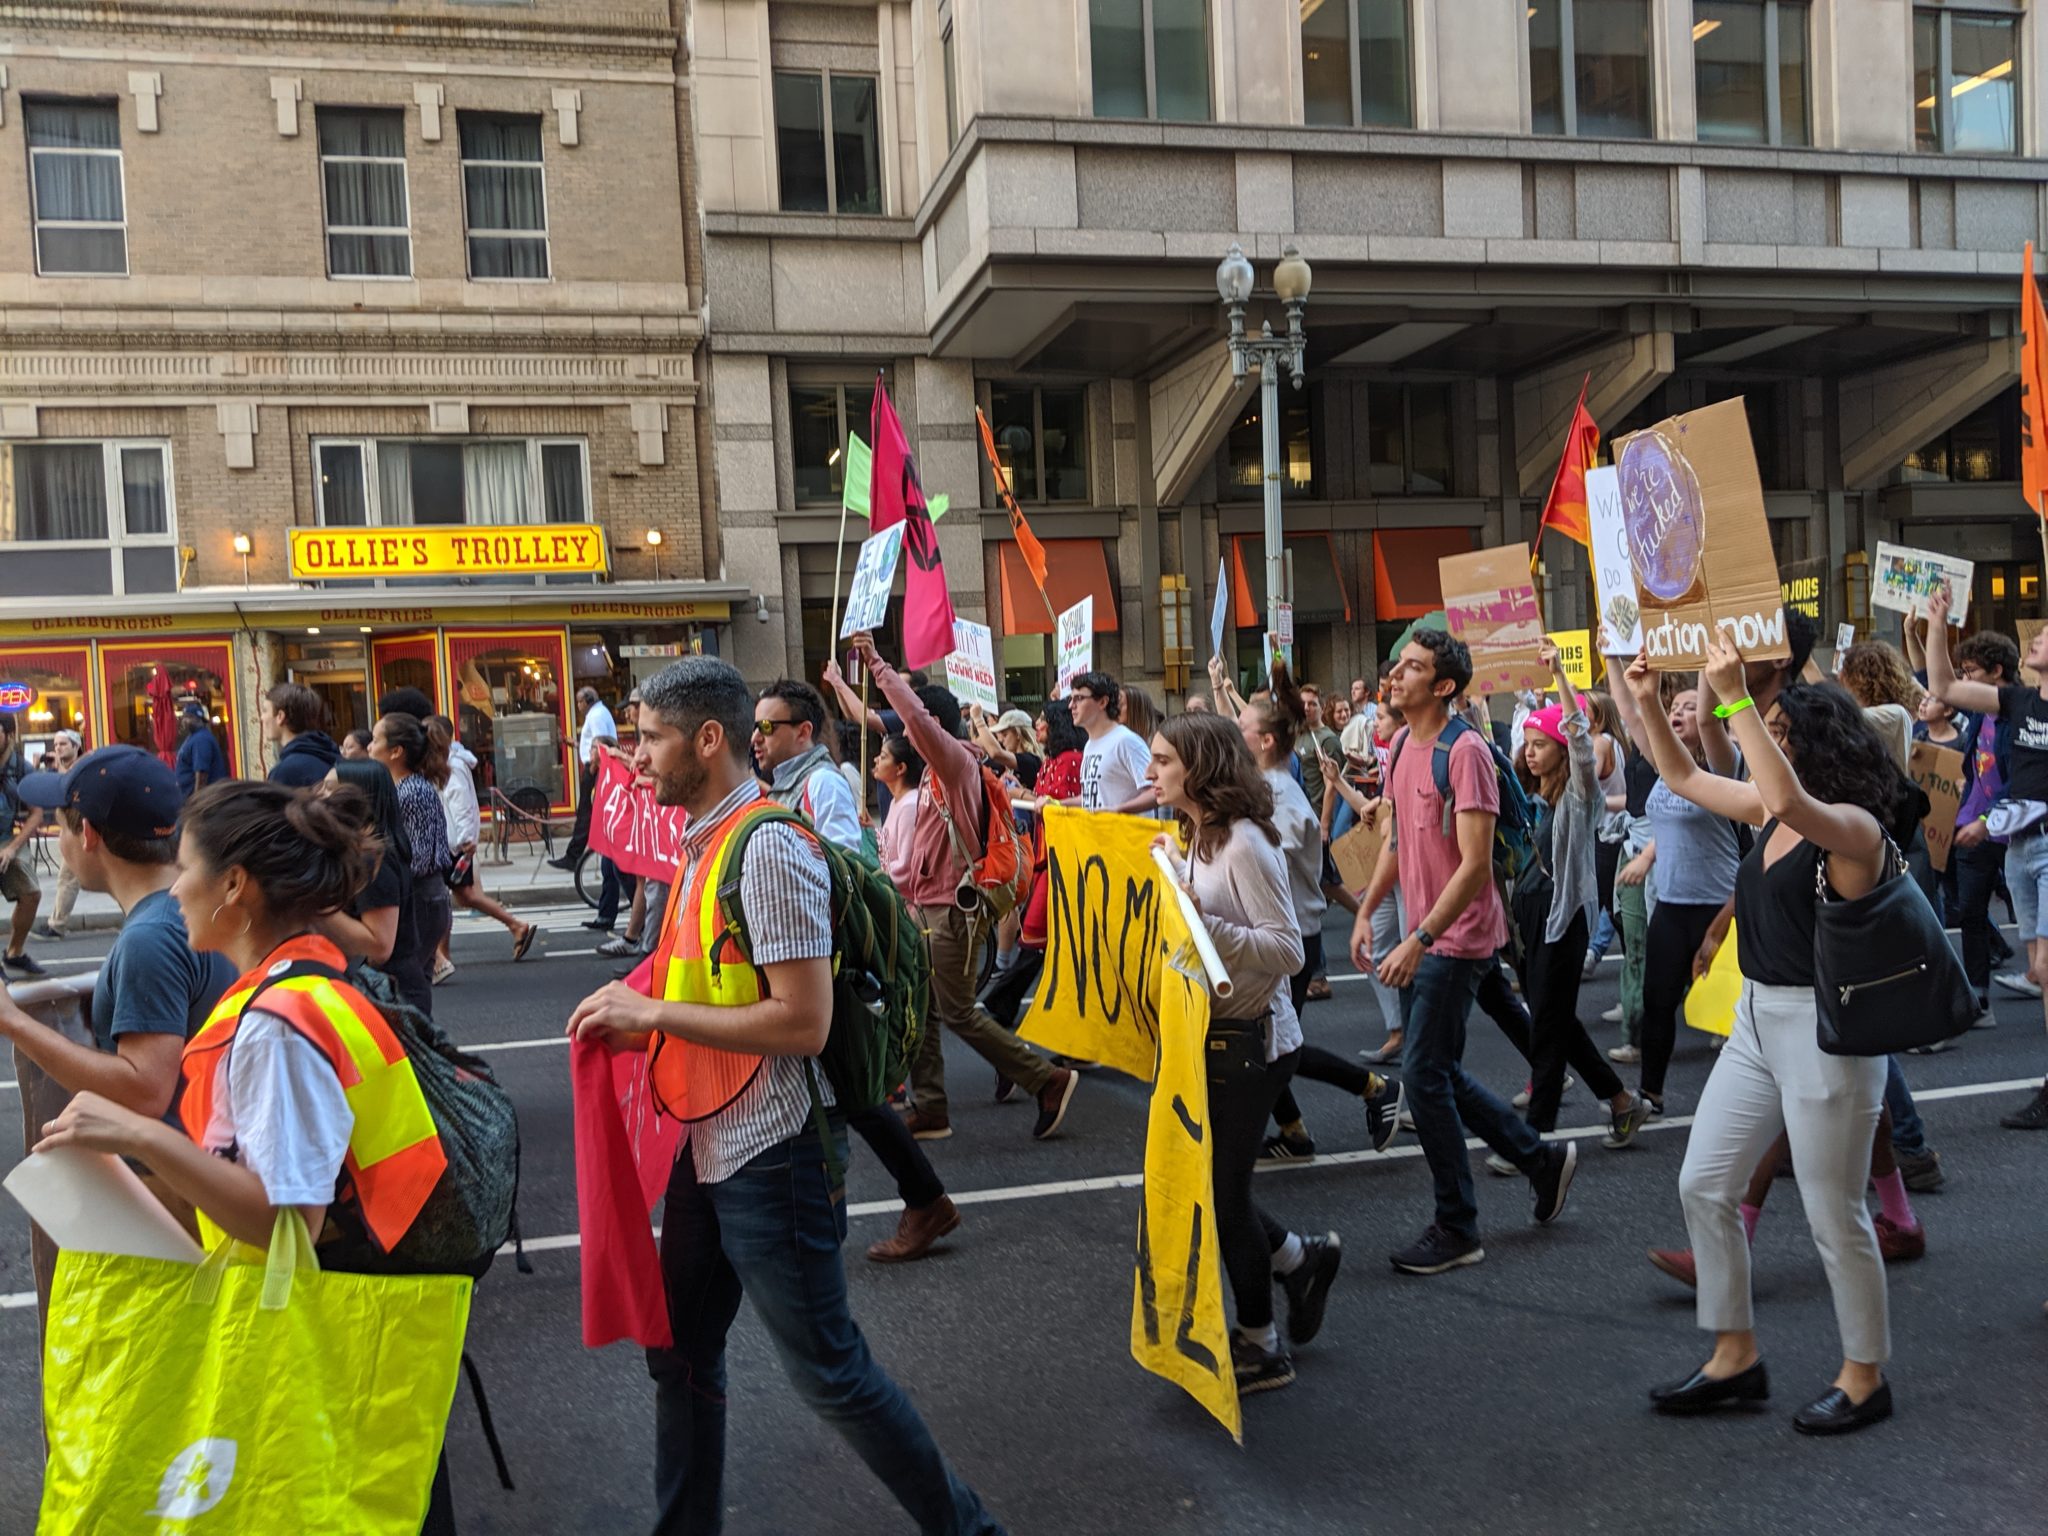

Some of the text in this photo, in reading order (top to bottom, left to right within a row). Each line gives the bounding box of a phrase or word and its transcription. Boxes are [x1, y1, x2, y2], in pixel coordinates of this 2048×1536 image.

[1626, 463, 1660, 514] we're
[1633, 471, 1682, 566] fucked
[306, 535, 590, 568] OLLIE'S TROLLEY
[857, 568, 880, 599] ONLY
[1604, 567, 1621, 590] DO
[1790, 576, 1819, 602] JOBS
[32, 614, 174, 631] OLLIEBURGERS
[320, 606, 433, 622] OLLIEFRIES
[570, 602, 695, 617] OLLIEBURGERS
[866, 587, 891, 627] ONE
[1646, 611, 1710, 657] action
[1716, 607, 1786, 650] now
[947, 660, 974, 681] CLOWNS
[974, 669, 994, 687] NEED
[0, 688, 31, 704] PEN
[1910, 770, 1960, 801] UTION
[1043, 846, 1122, 1025] NO
